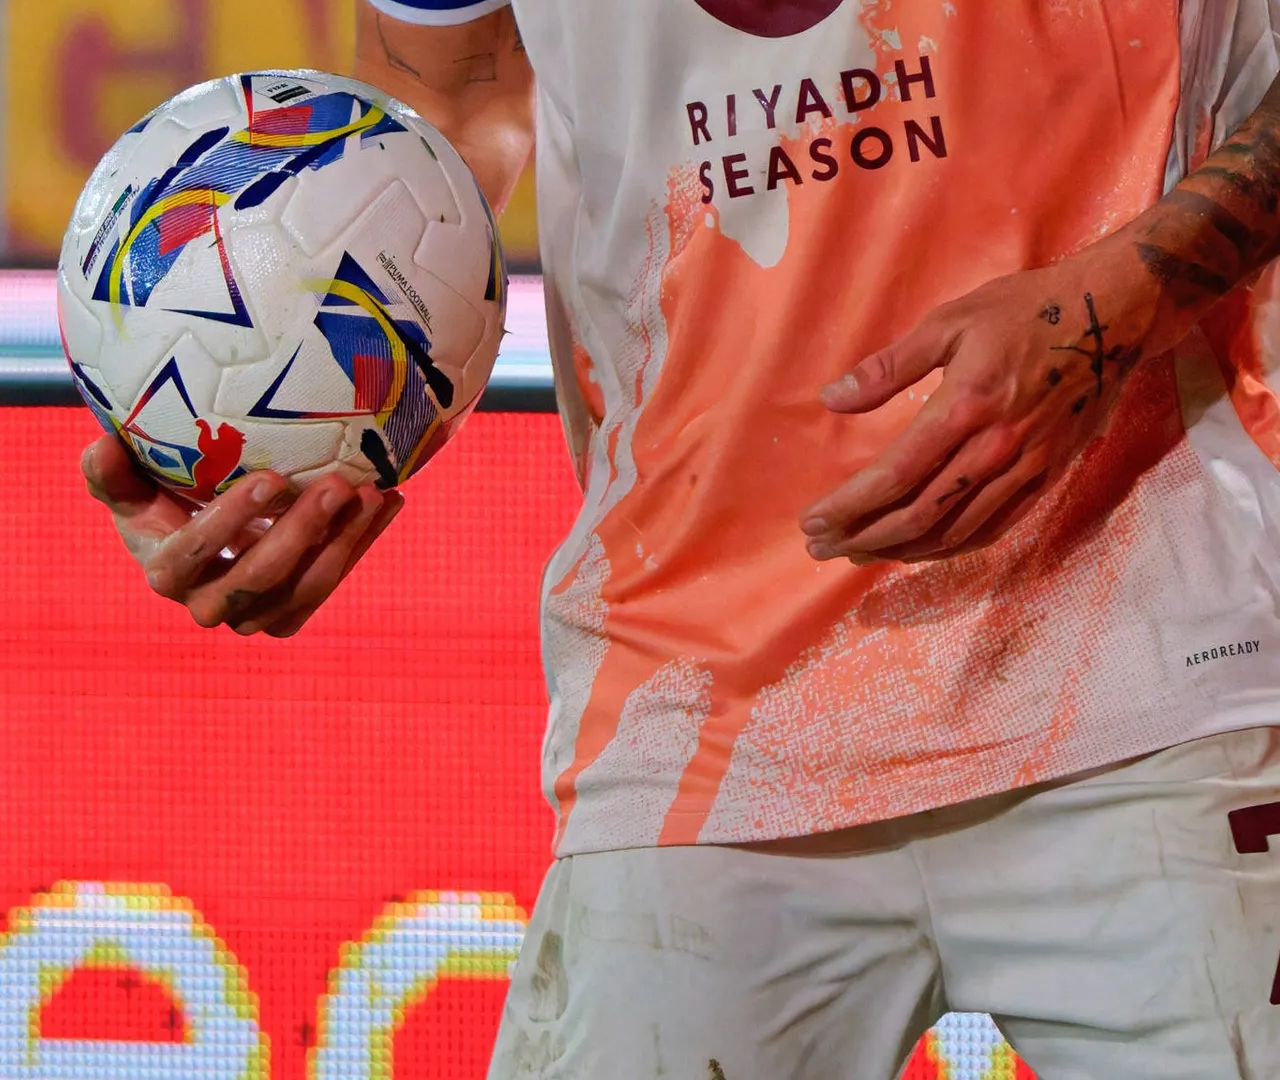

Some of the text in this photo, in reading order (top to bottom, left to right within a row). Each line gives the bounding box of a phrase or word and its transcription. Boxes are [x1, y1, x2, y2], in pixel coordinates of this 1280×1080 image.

[686, 55, 936, 146] RIYADH
[698, 115, 949, 205] SEASON
[389, 263, 432, 323] PUMA FOOTBALL
[1185, 640, 1261, 668] AEROREADY
